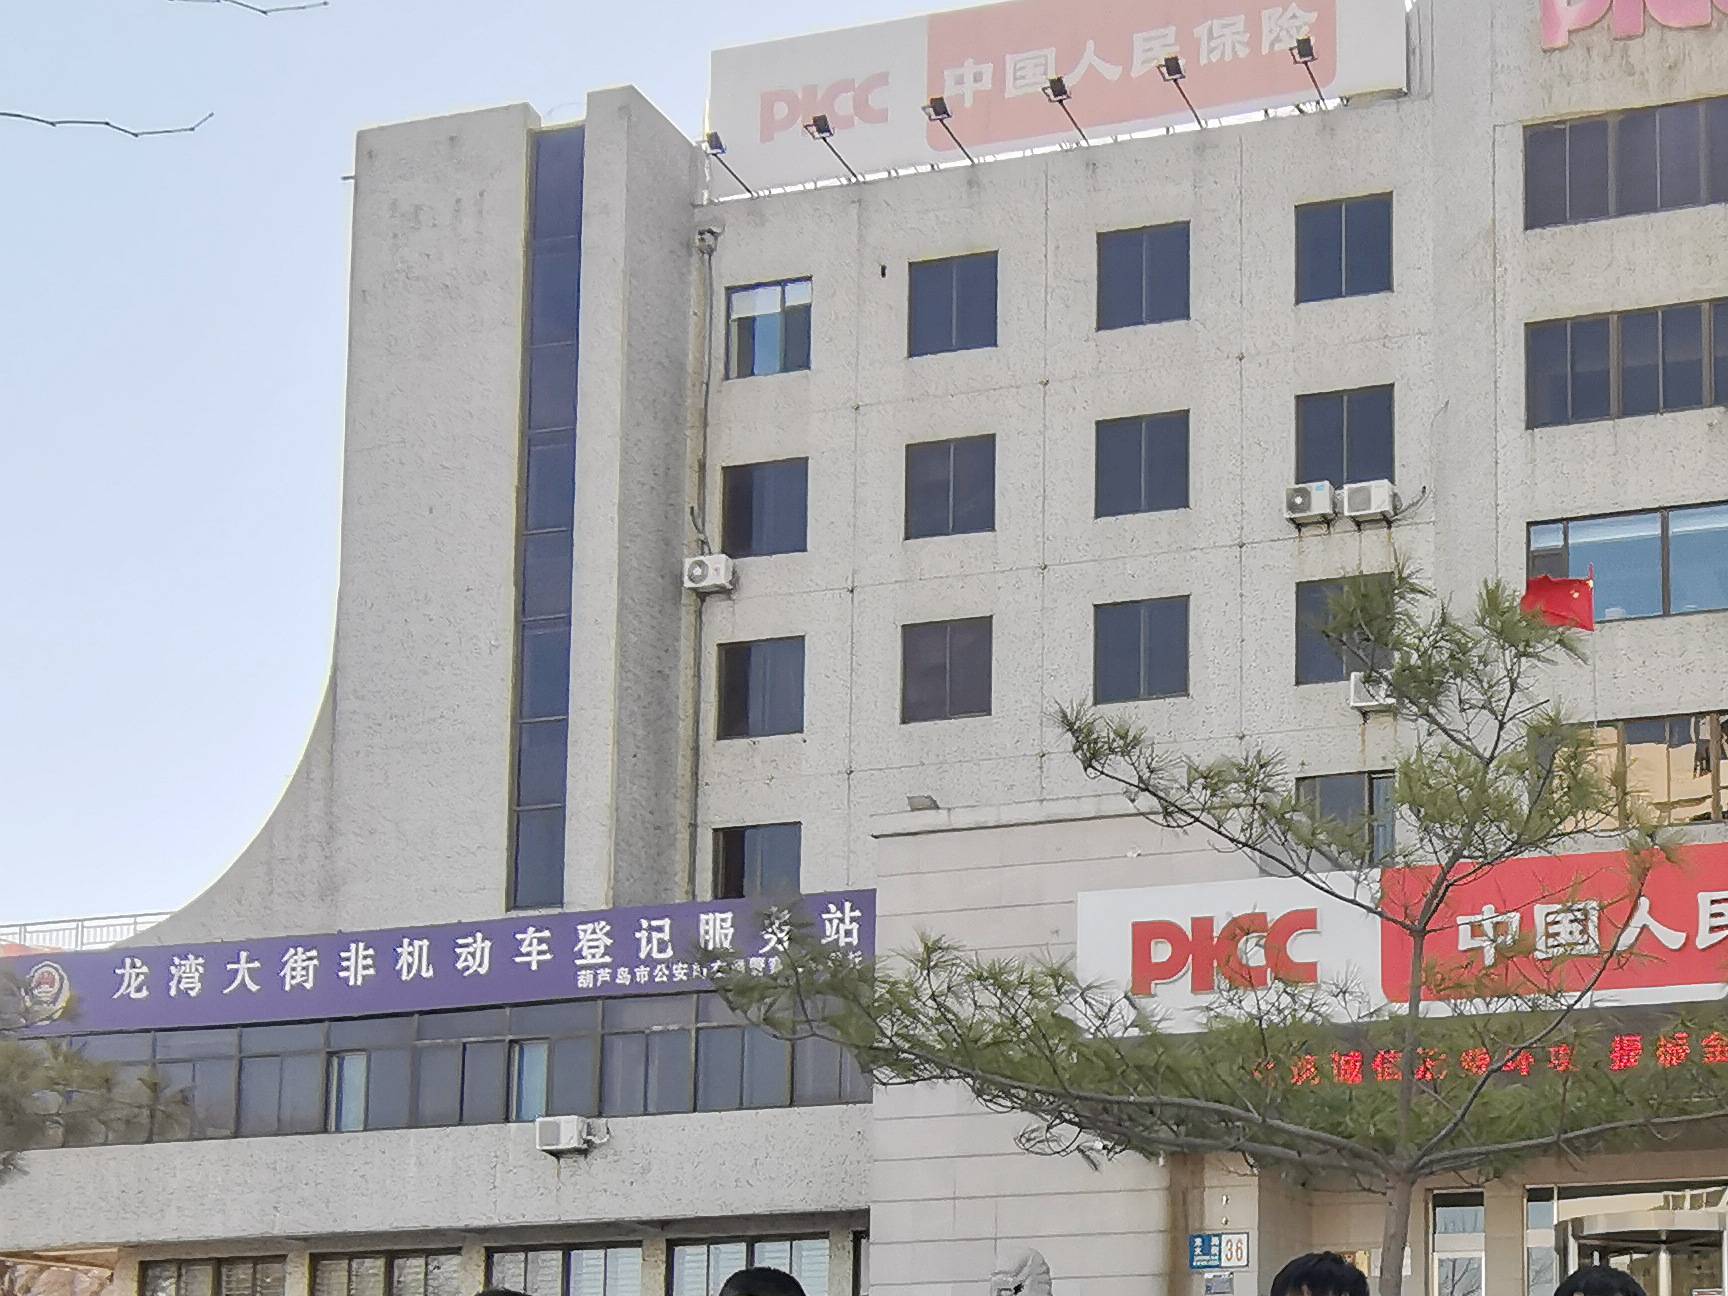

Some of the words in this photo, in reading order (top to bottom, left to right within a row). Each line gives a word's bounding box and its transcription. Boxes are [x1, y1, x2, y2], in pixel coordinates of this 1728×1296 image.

[943, 1, 1319, 108] 中国人民保险
[759, 71, 891, 144] PICC
[111, 899, 863, 1001] 龙湾大街非机动车登记服务站
[1130, 907, 1319, 996] PICC
[1225, 1238, 1244, 1262] 36
